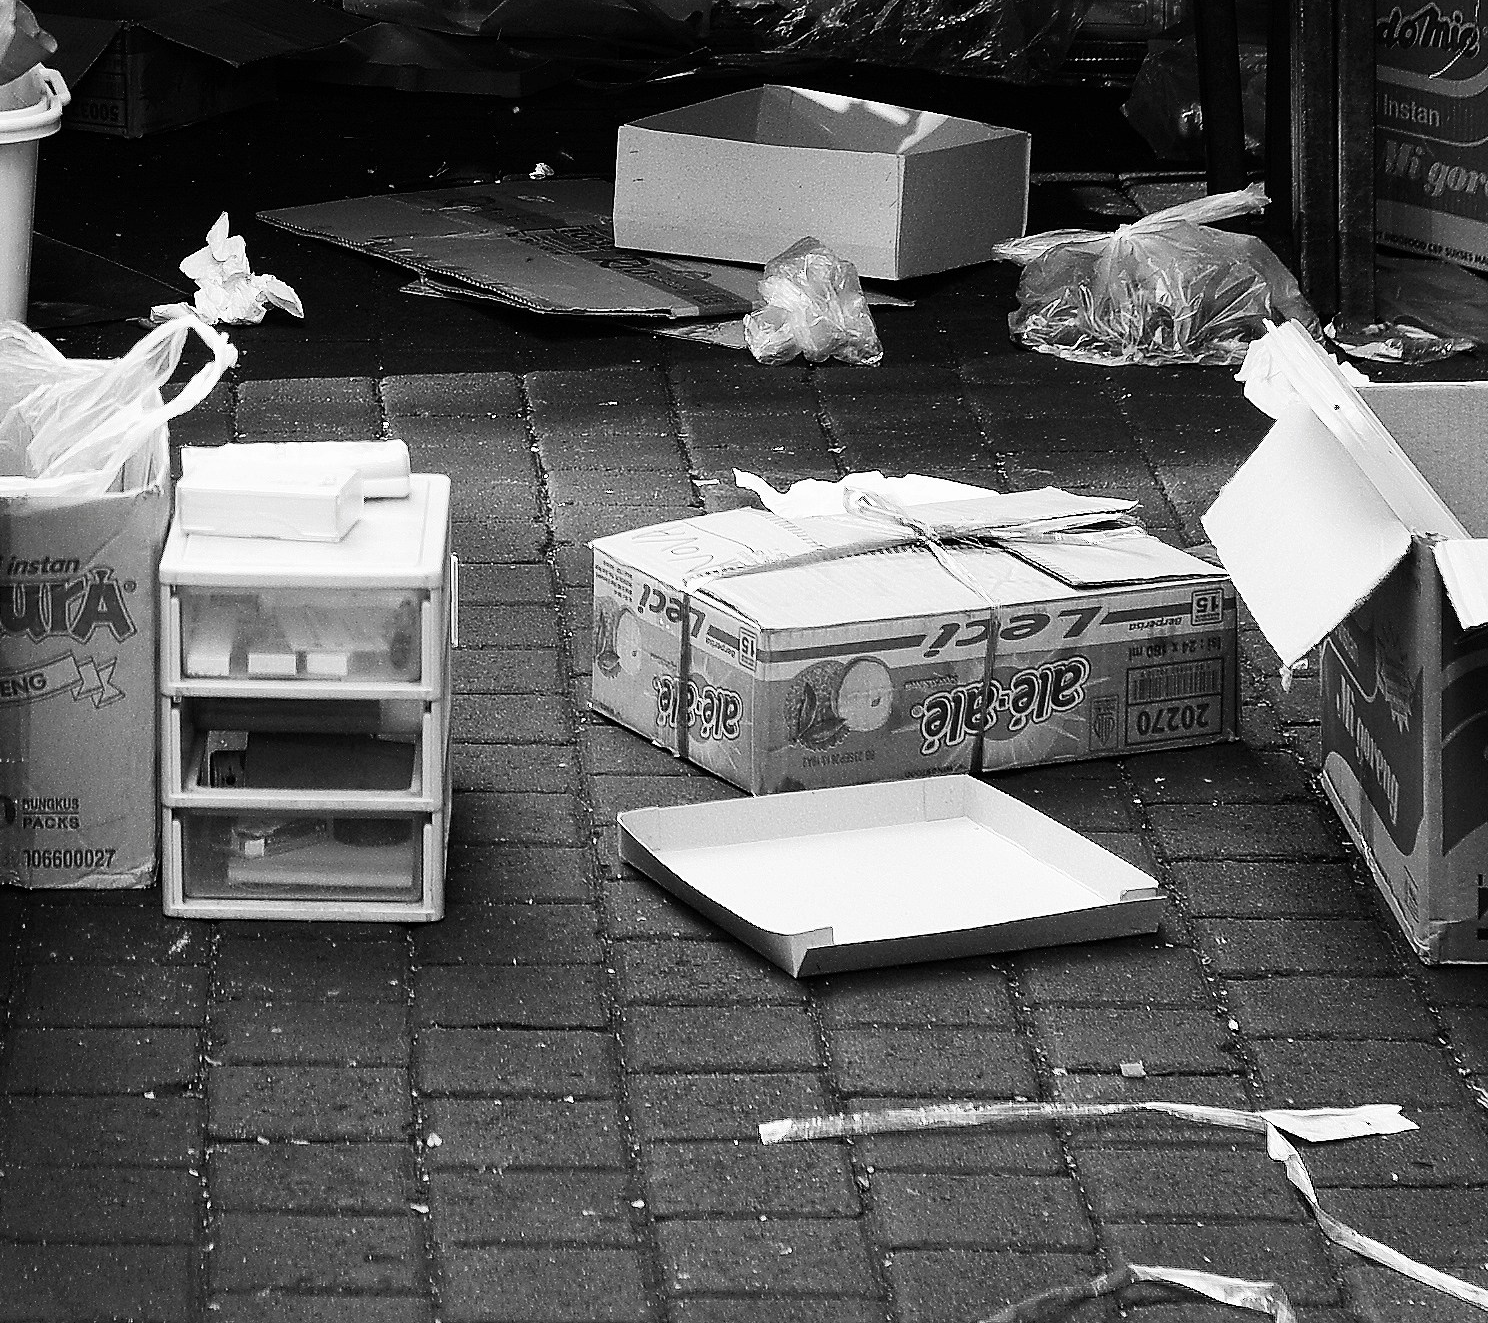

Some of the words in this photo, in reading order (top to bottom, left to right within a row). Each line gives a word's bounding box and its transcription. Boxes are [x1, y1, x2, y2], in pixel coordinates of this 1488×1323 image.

[1383, 92, 1441, 128] Instan
[7, 556, 81, 576] instan
[1195, 595, 1220, 615] 15
[923, 605, 1104, 659] Leci
[740, 636, 755, 658] 15
[1181, 639, 1197, 654] 24
[1136, 704, 1210, 736] 20270
[1356, 717, 1400, 828] goreng
[23, 815, 81, 831] PACKS
